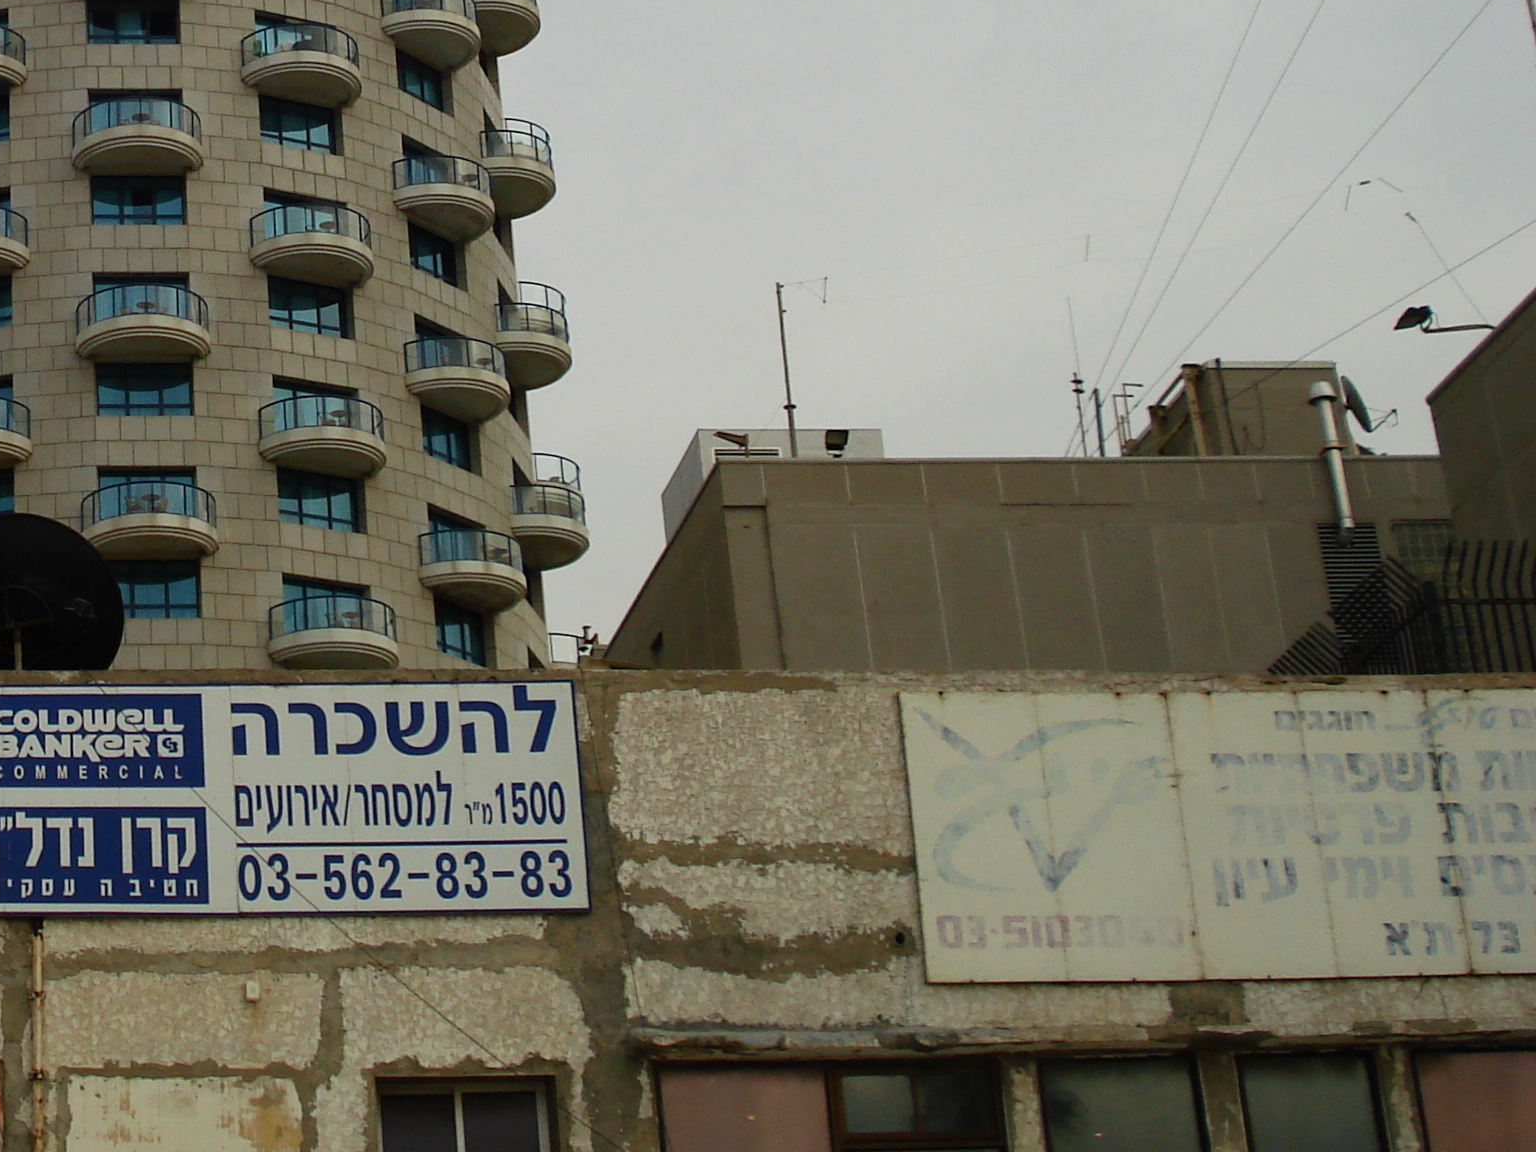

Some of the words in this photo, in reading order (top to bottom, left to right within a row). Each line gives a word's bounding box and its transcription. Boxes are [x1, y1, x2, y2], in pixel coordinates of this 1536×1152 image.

[230, 685, 556, 756] להשכרה
[495, 781, 566, 825] 1500
[121, 817, 196, 874] קרן
[100, 879, 198, 897] חטיבה
[238, 850, 572, 901] 03-562-83-83
